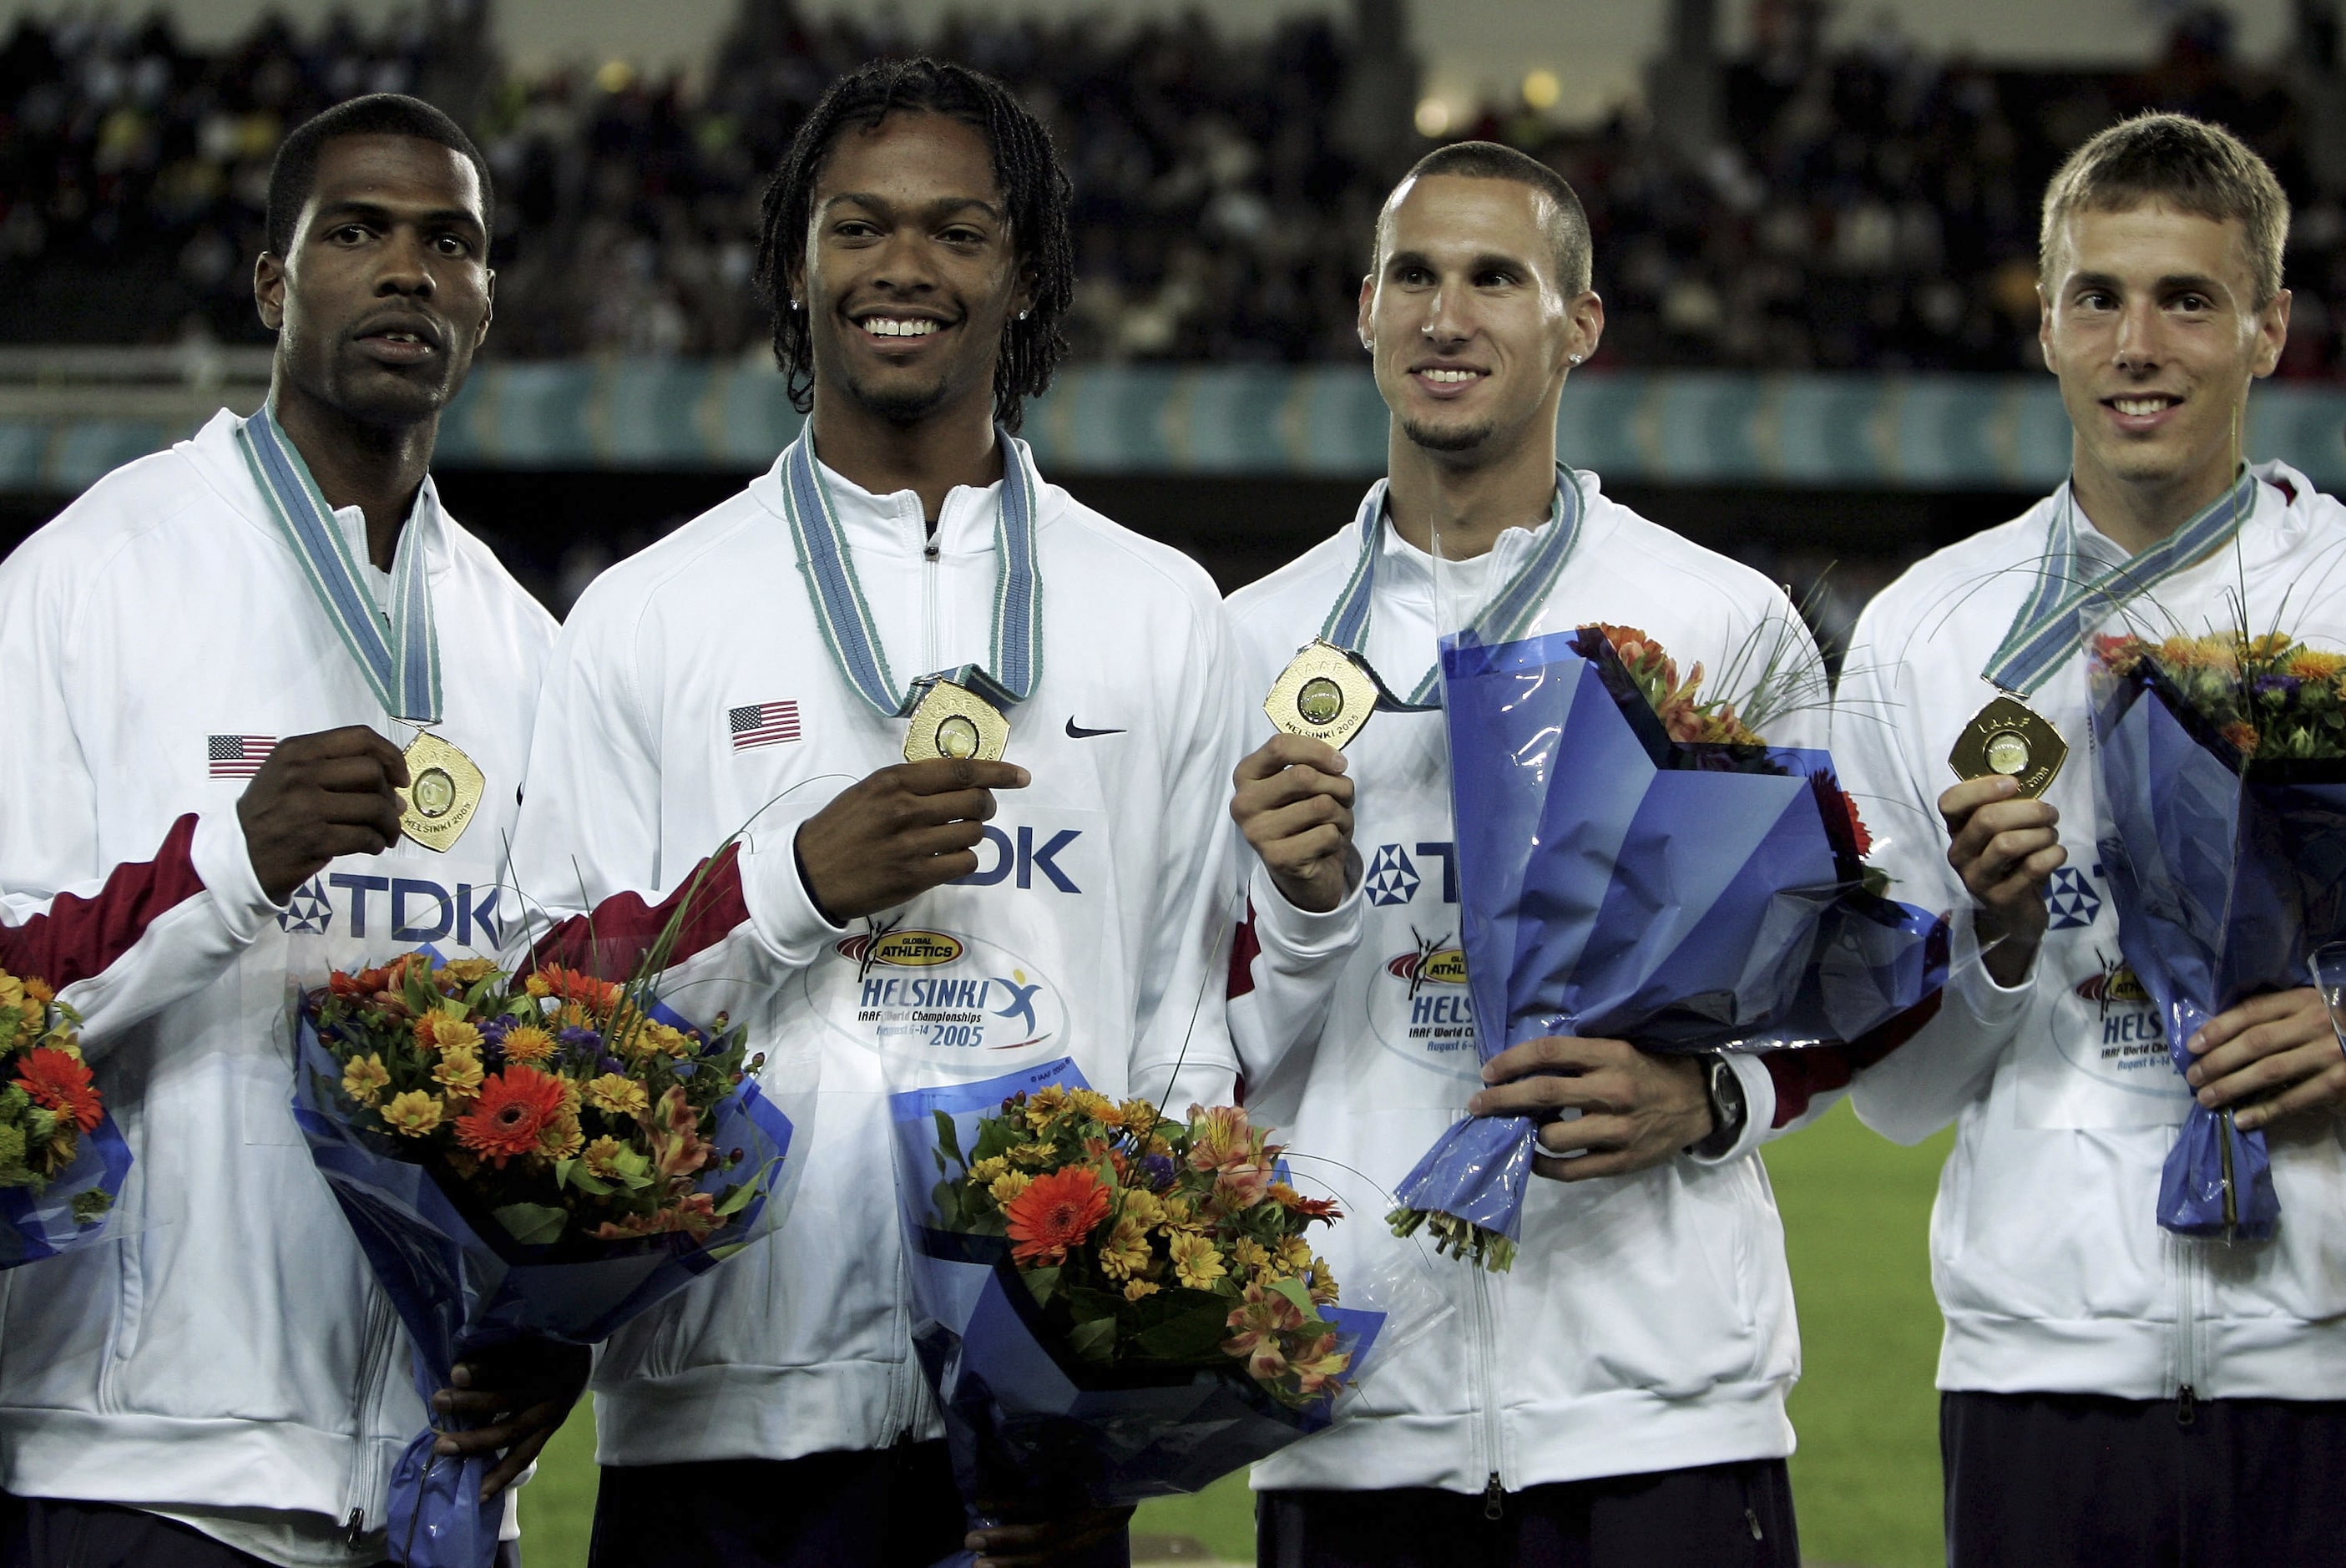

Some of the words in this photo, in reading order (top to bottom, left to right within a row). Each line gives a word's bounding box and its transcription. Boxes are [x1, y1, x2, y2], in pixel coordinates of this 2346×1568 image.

[1337, 715, 1359, 734] 2005
[1978, 716, 2030, 734] IAAF
[404, 817, 452, 834] HELSINKI
[452, 802, 471, 824] 2005
[943, 824, 1082, 893] DK
[330, 873, 501, 952] TDK
[881, 946, 953, 958] ATHLETICS
[861, 979, 989, 1009] HELSINKI
[857, 1010, 882, 1022] IAAF
[912, 1011, 982, 1024] Championships
[1412, 996, 1473, 1024] HELS
[929, 1025, 984, 1047] 2005
[1408, 1028, 1432, 1038] IAAF
[1434, 1027, 1463, 1038] World
[2103, 1011, 2163, 1044] HELS
[1427, 1040, 1459, 1053] August
[2123, 1044, 2150, 1055] World
[2117, 1058, 2147, 1072] August
